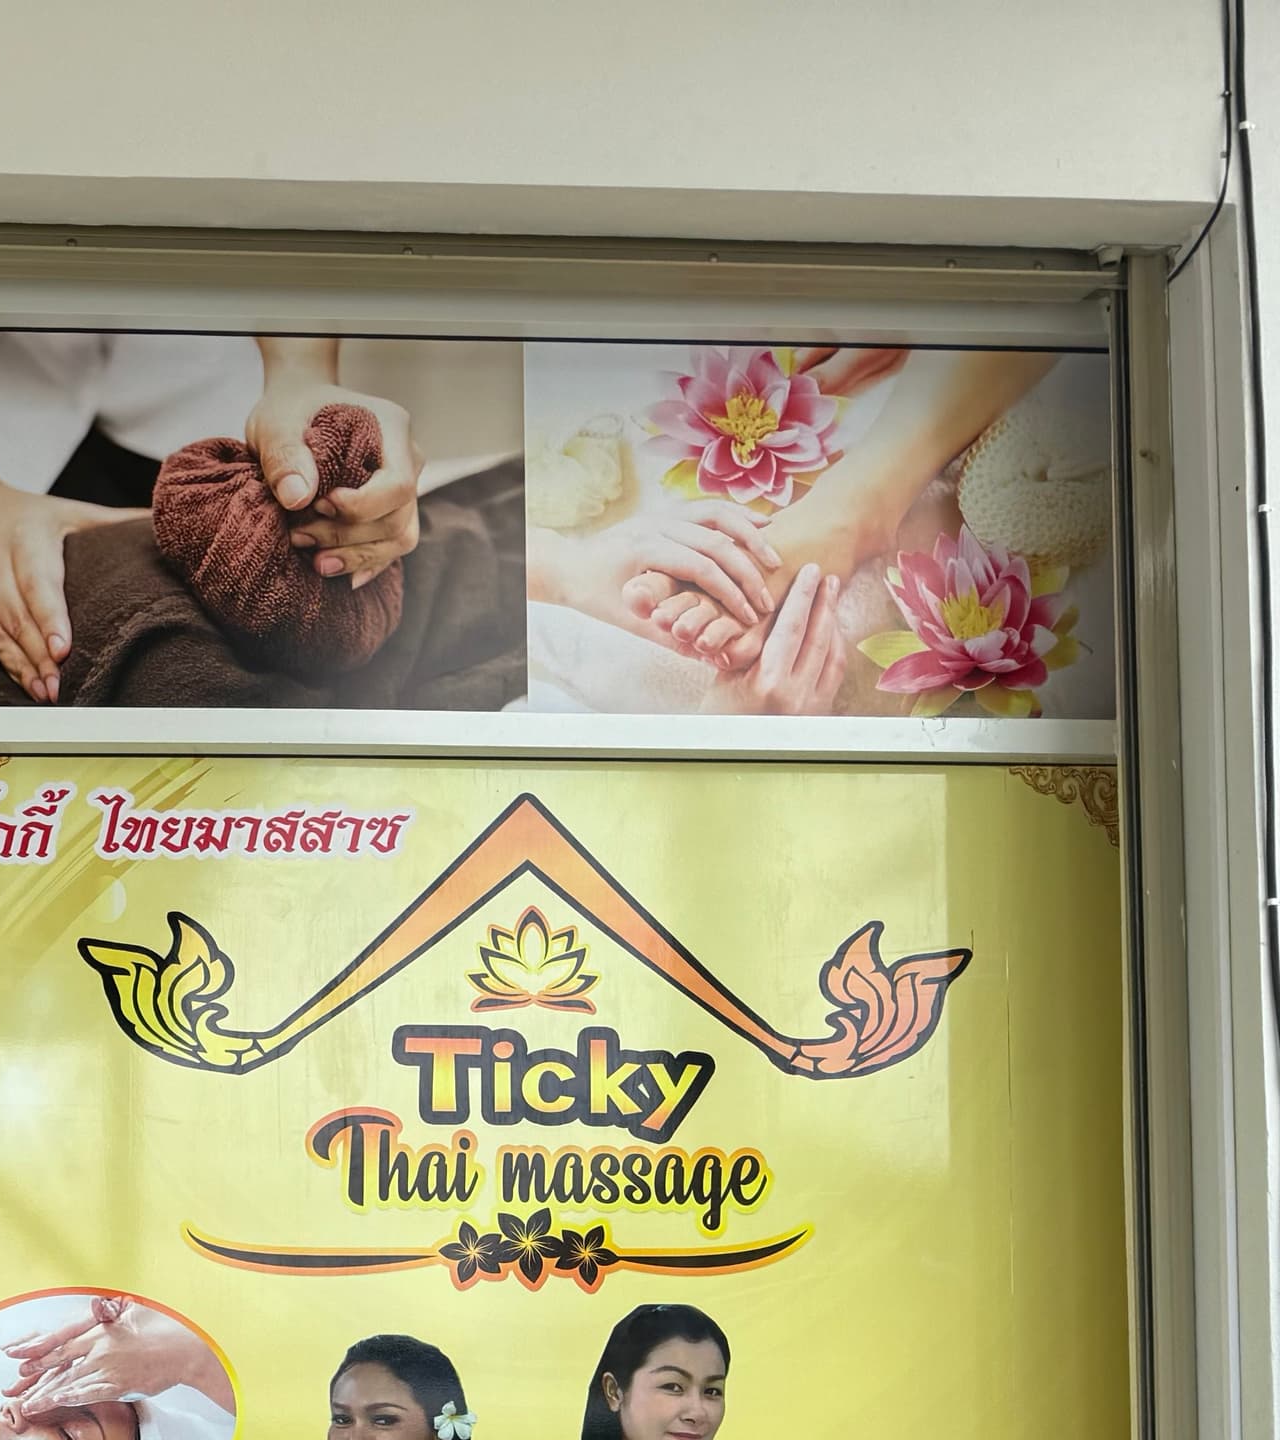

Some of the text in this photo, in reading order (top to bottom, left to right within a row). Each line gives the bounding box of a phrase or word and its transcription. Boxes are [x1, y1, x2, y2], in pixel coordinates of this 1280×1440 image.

[397, 1029, 710, 1139] Ticky
[310, 1110, 769, 1231] Thai massage
